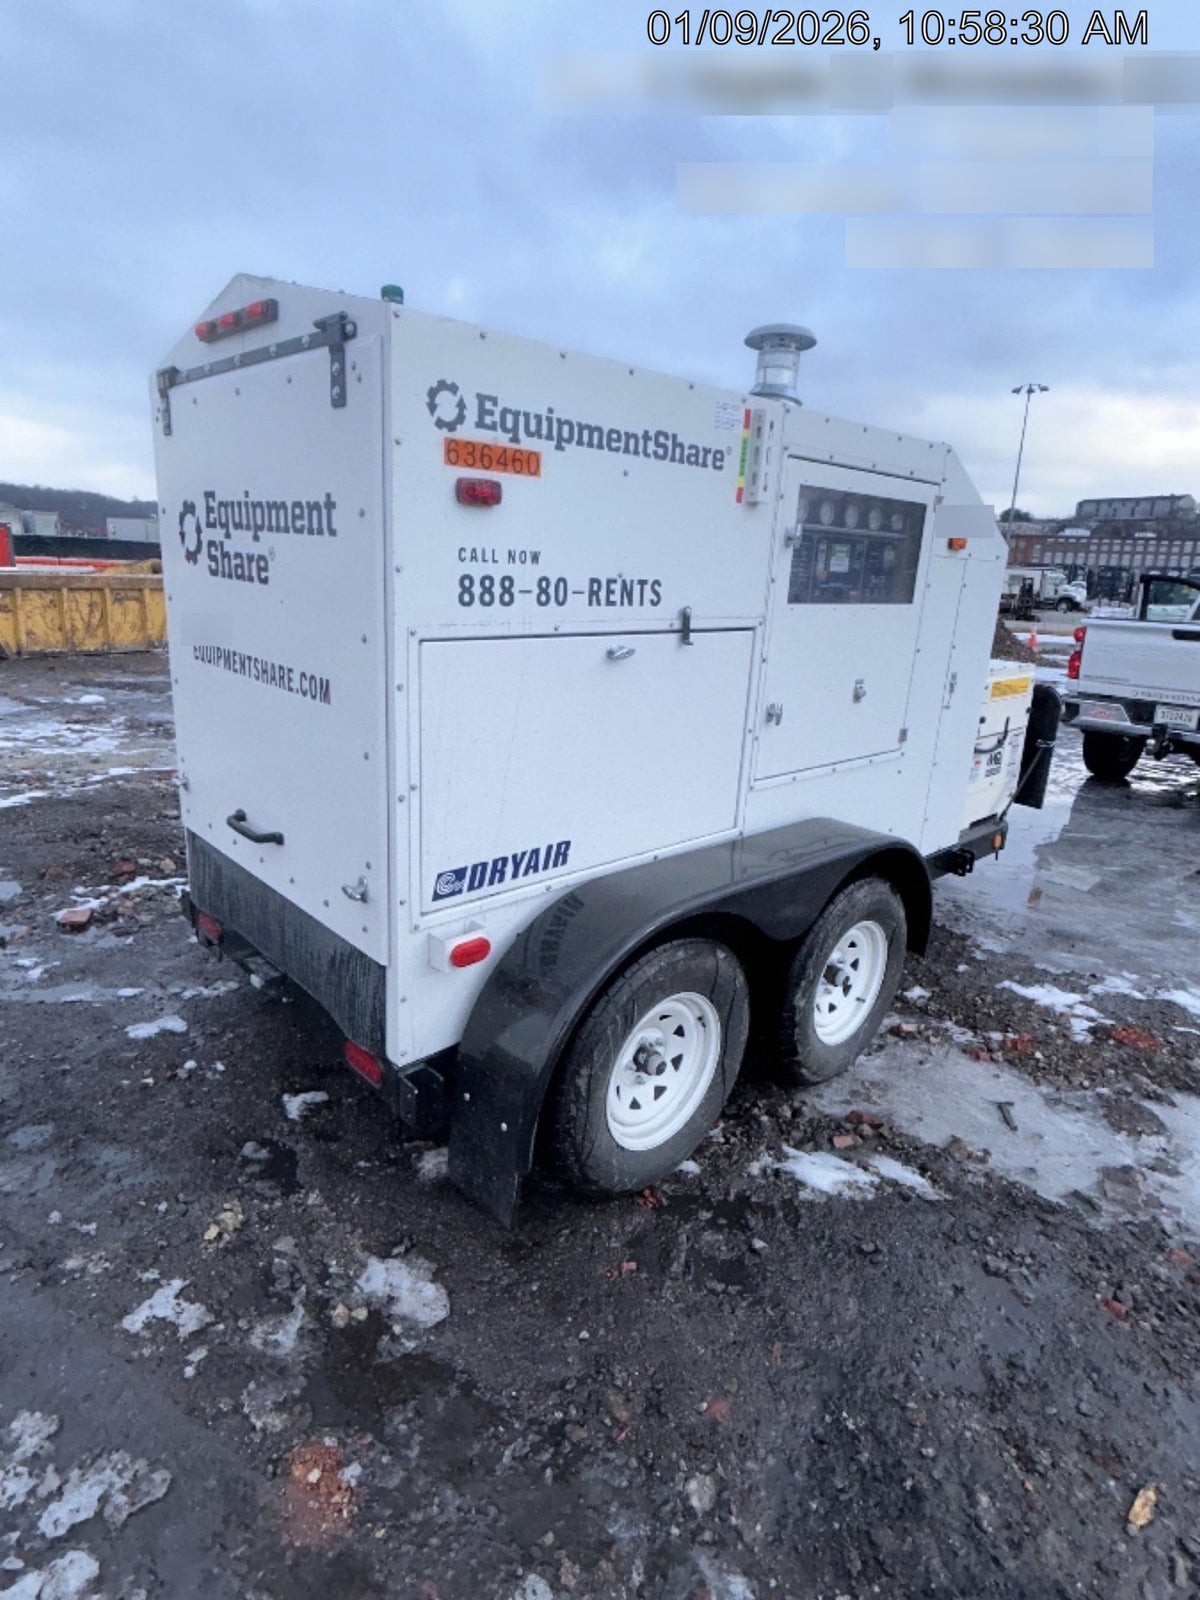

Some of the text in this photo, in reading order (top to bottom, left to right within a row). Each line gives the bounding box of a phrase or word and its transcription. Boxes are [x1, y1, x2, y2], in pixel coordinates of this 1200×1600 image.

[475, 392, 725, 471] EquipmentShare
[446, 439, 540, 476] 636460
[203, 490, 337, 542] Equipment
[207, 540, 269, 585] Share
[458, 547, 541, 565] CALL NOW
[458, 573, 662, 607] 888-80-RENTS
[466, 840, 571, 892] DRYAIR
